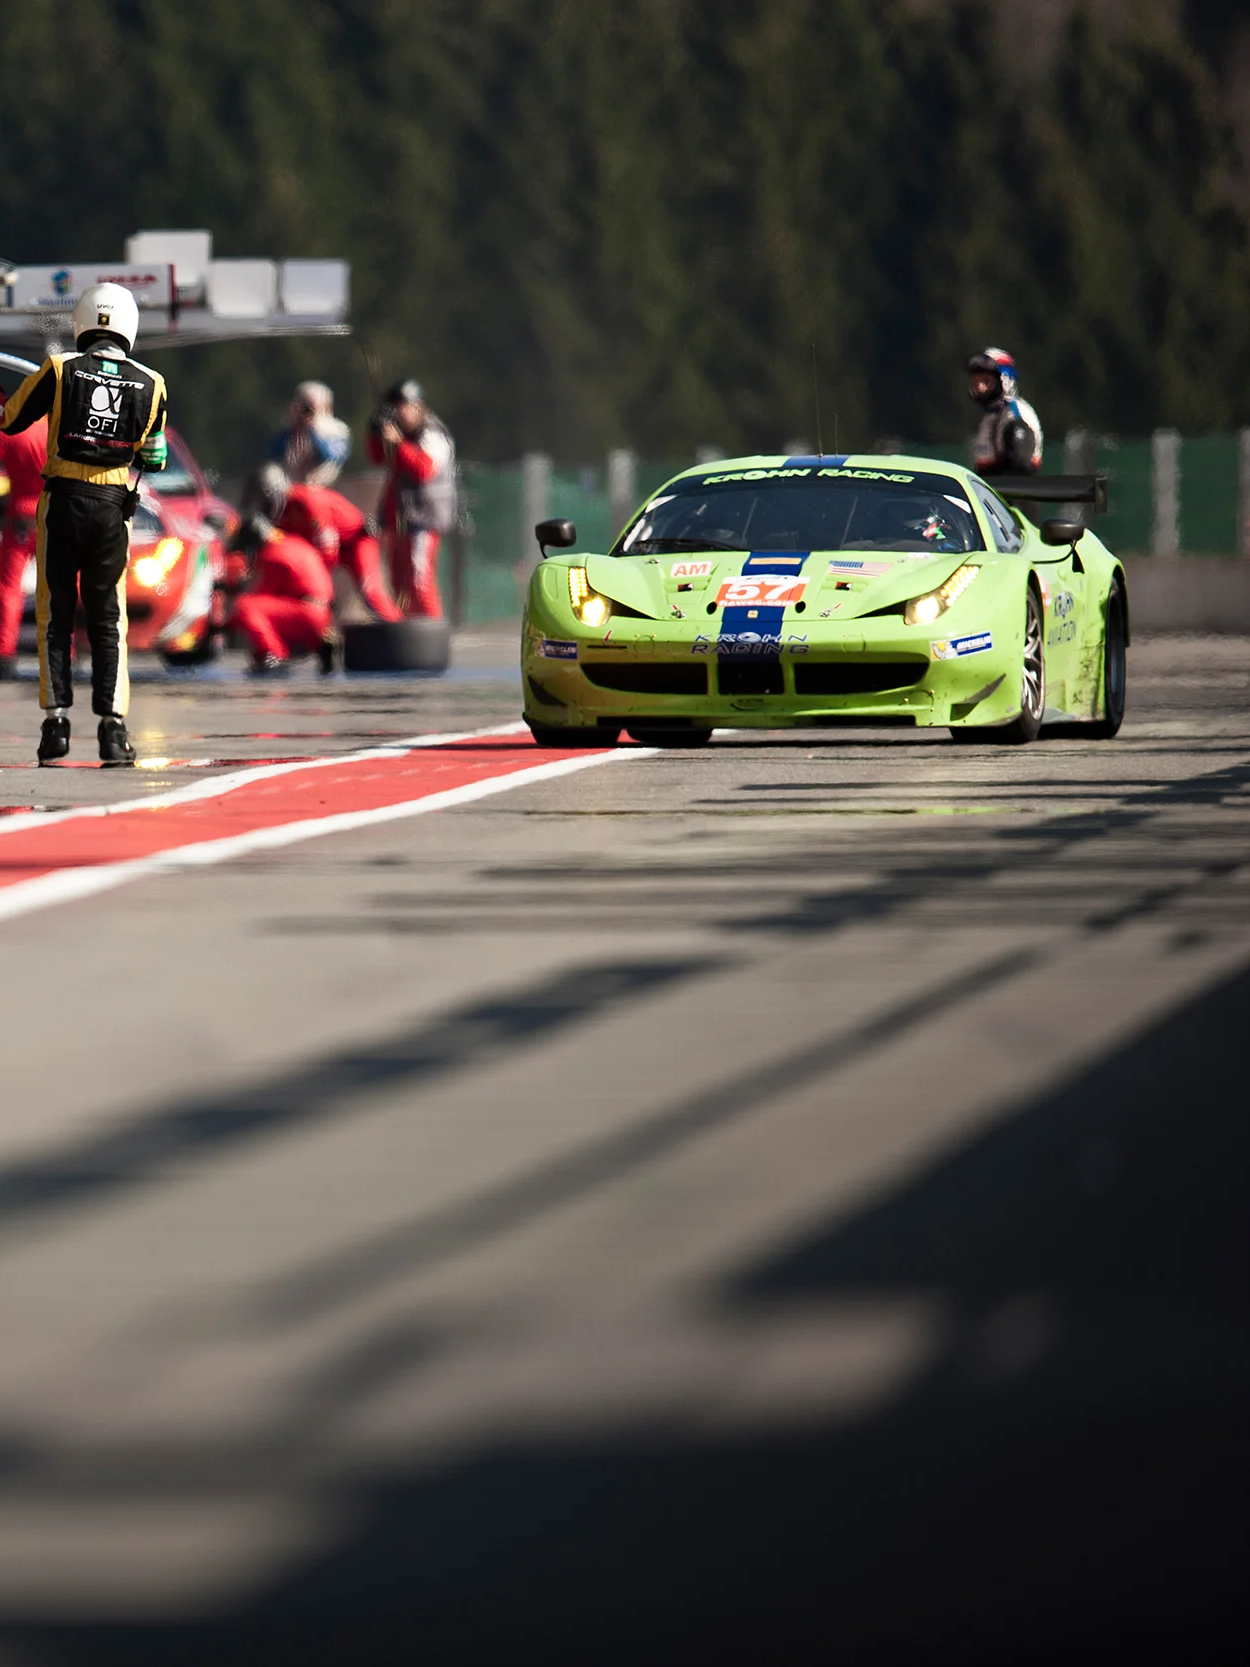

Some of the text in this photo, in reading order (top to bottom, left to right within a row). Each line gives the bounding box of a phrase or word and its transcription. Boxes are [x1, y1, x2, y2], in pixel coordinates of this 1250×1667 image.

[87, 415, 118, 433] OFI
[703, 469, 914, 485] KROHN RACING
[674, 563, 707, 577] AM
[725, 579, 799, 600] 57
[694, 631, 808, 643] KROHN
[691, 643, 810, 655] RACING
